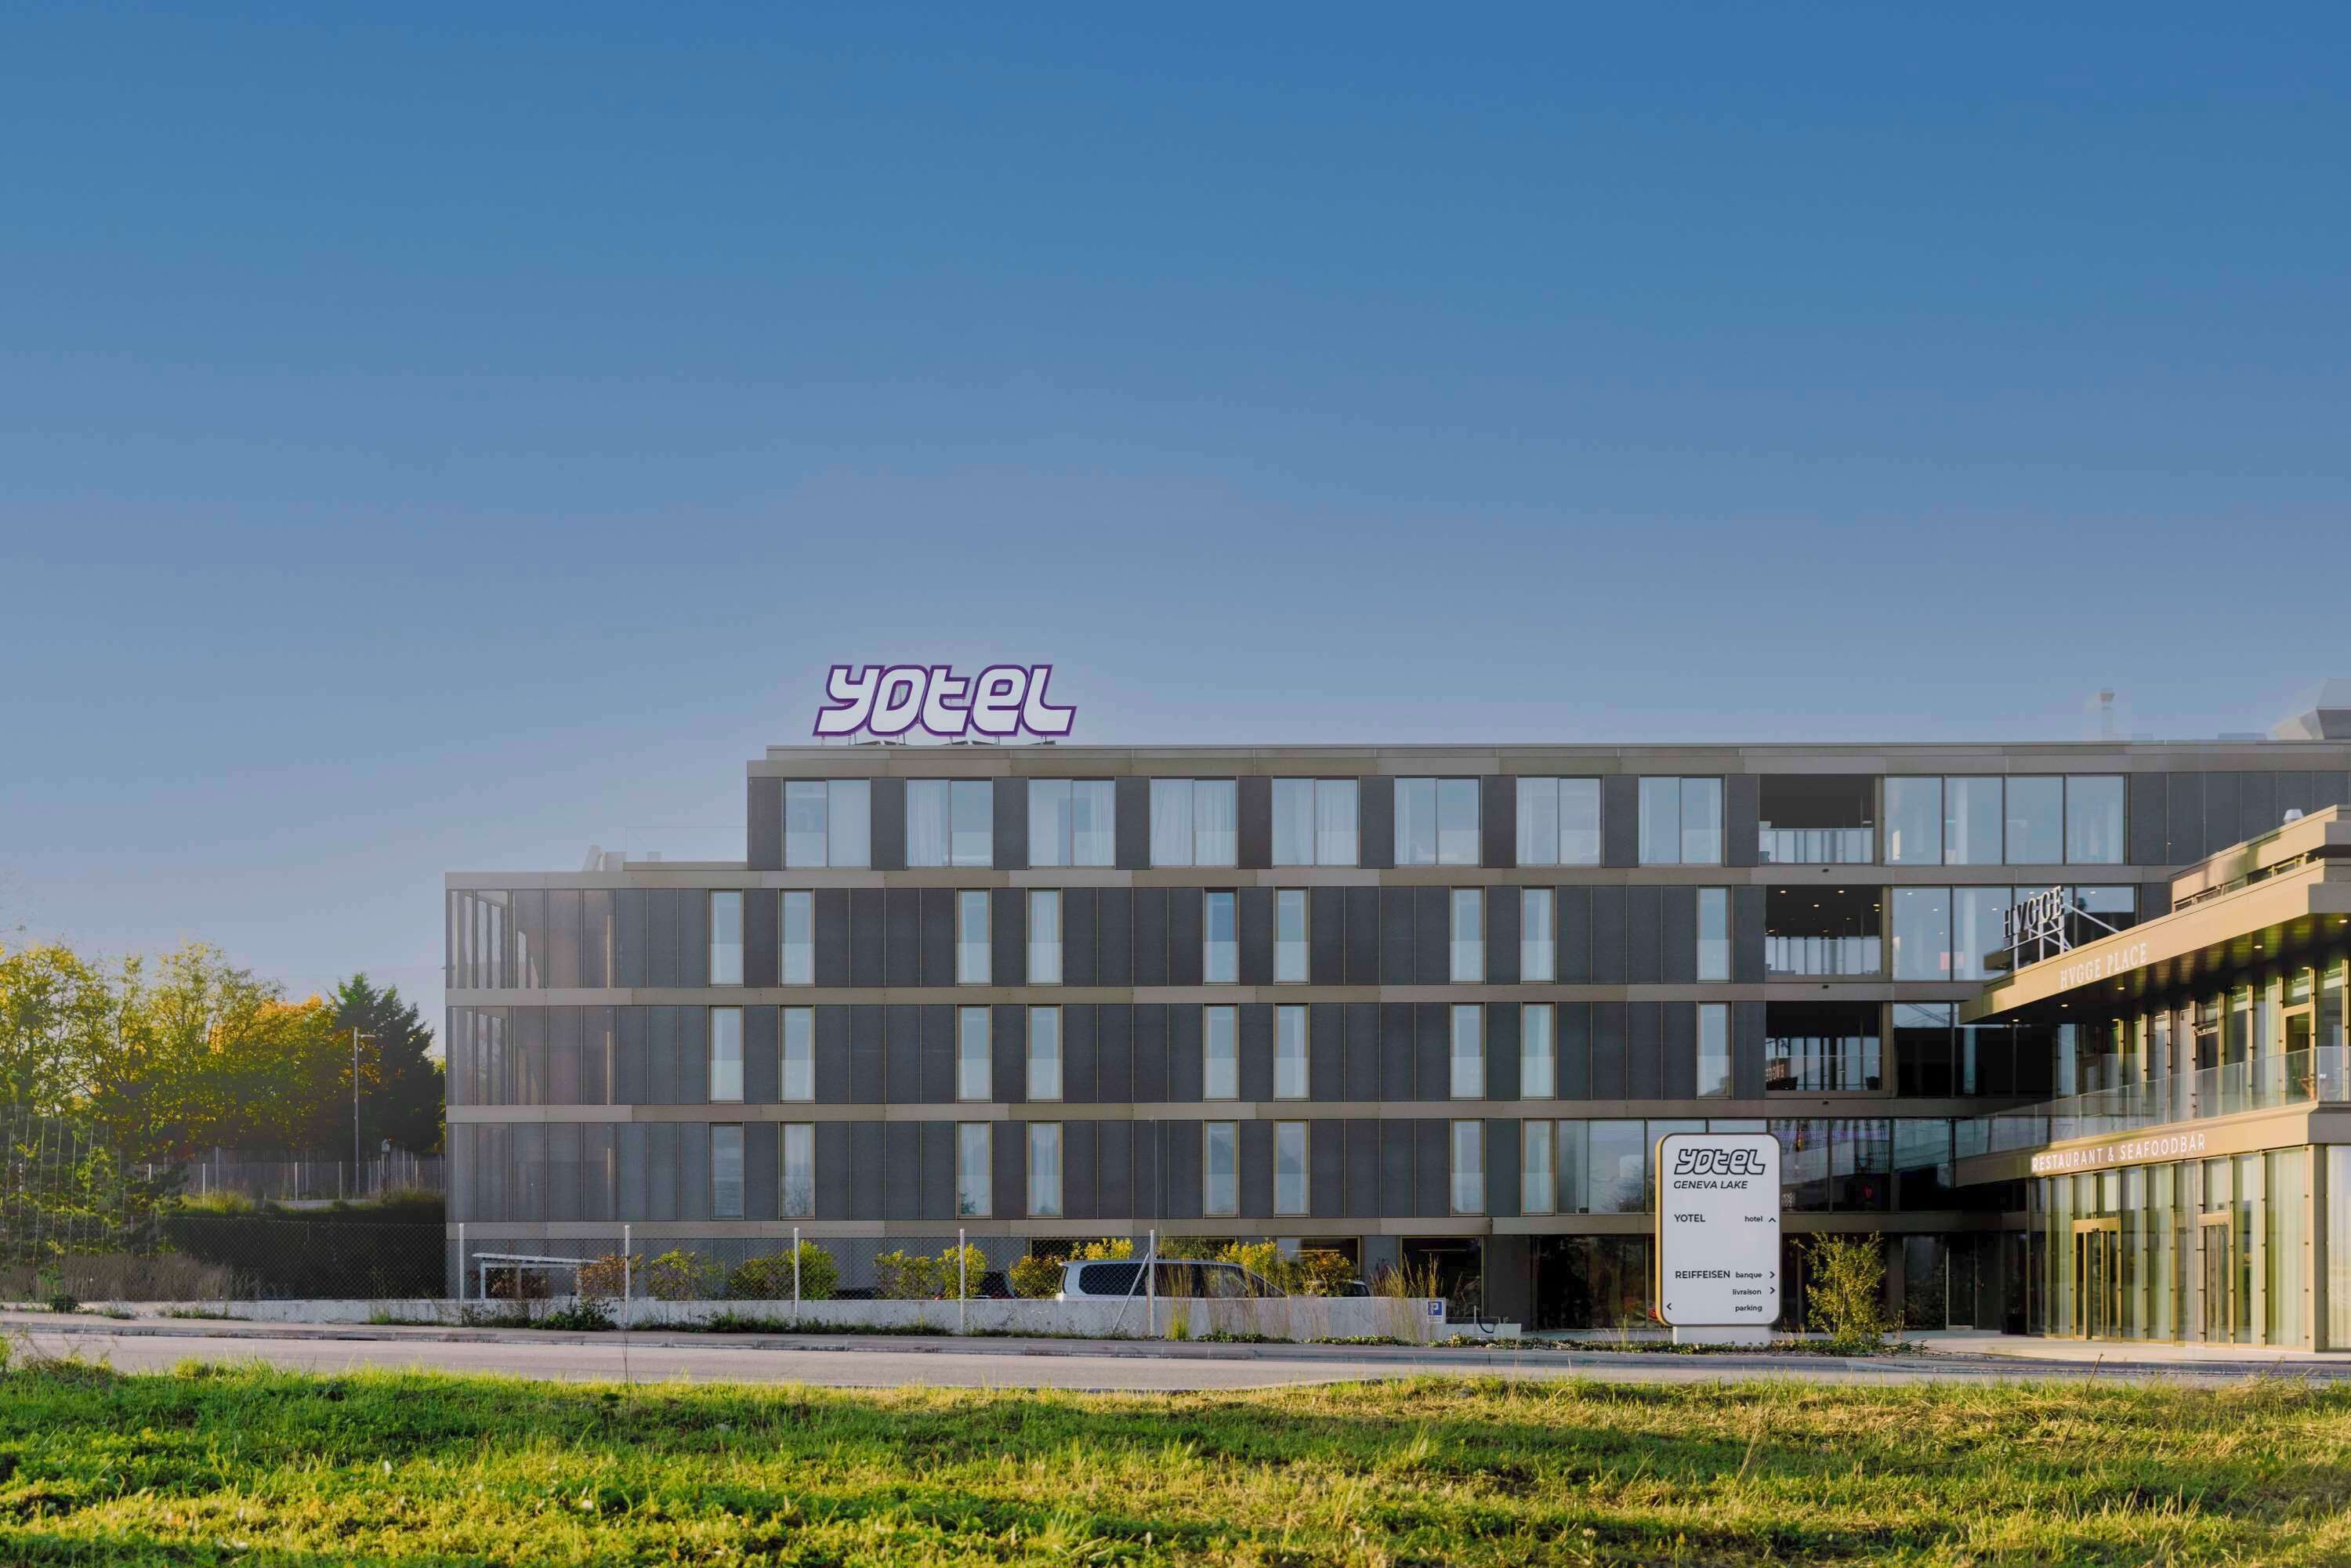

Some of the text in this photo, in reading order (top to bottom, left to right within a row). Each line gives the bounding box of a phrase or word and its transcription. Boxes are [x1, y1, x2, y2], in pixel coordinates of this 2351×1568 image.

[2106, 943, 2147, 974] PLACE
[2031, 1134, 2205, 1173] RESTAURANT & SEAFOODBAR
[1674, 1180, 1748, 1189] GENEVA LAKE
[1674, 1214, 1705, 1222] YOTEL
[1675, 1269, 1730, 1279] REIFFEISEN
[1430, 1302, 1439, 1314] P
